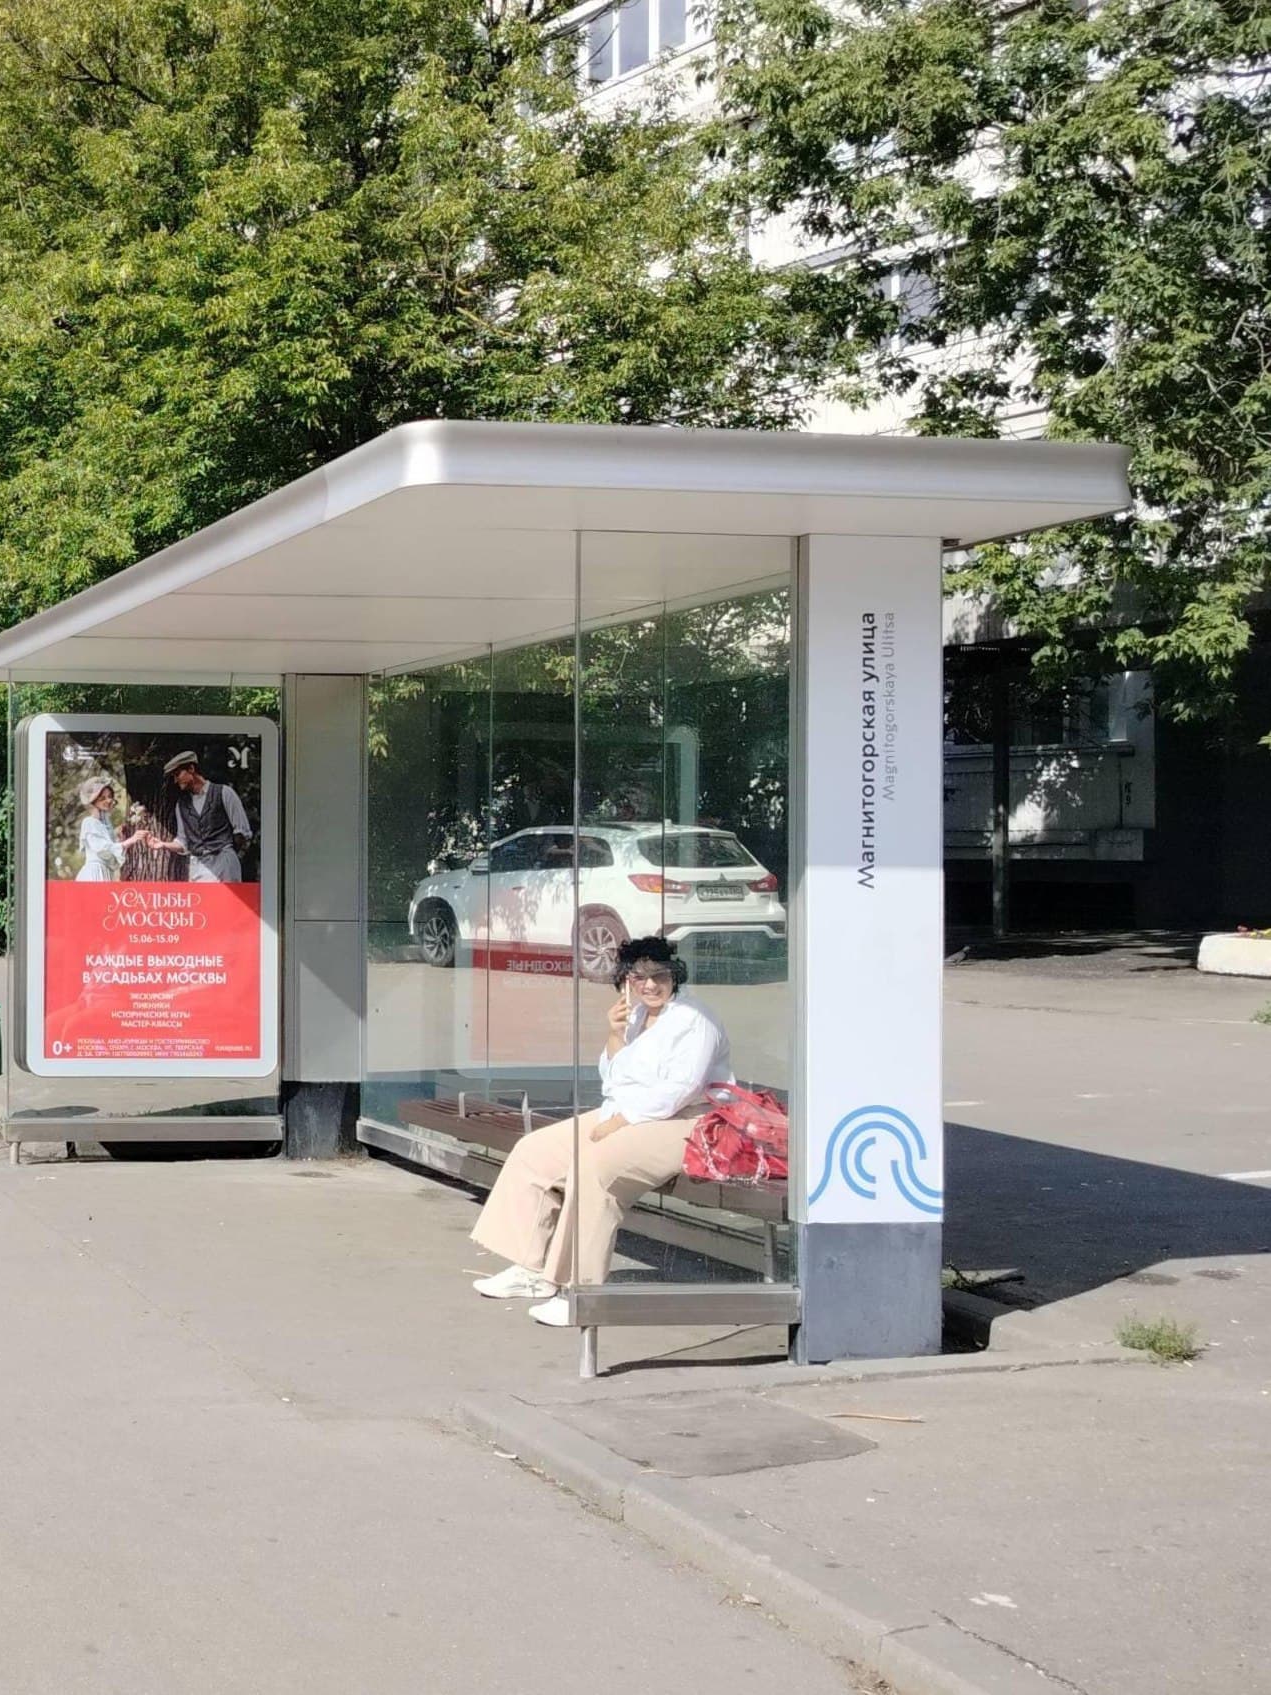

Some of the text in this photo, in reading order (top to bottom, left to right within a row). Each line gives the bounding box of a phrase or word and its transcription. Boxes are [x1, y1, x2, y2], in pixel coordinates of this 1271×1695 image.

[882, 612, 898, 801] Magnitogorskaya Ulitsa
[858, 612, 880, 889] Магнитогорская улица
[108, 888, 202, 912] УСАДЬБЫ
[103, 911, 207, 931] МОСКВЫ
[128, 934, 180, 944] 15.06-15.09
[85, 954, 224, 968] КАЖДЫЕ ВЫХОДНЫЕ
[82, 971, 227, 985] В УСАДЬБАХ МОСКВЫ
[52, 1040, 73, 1055] 0+
